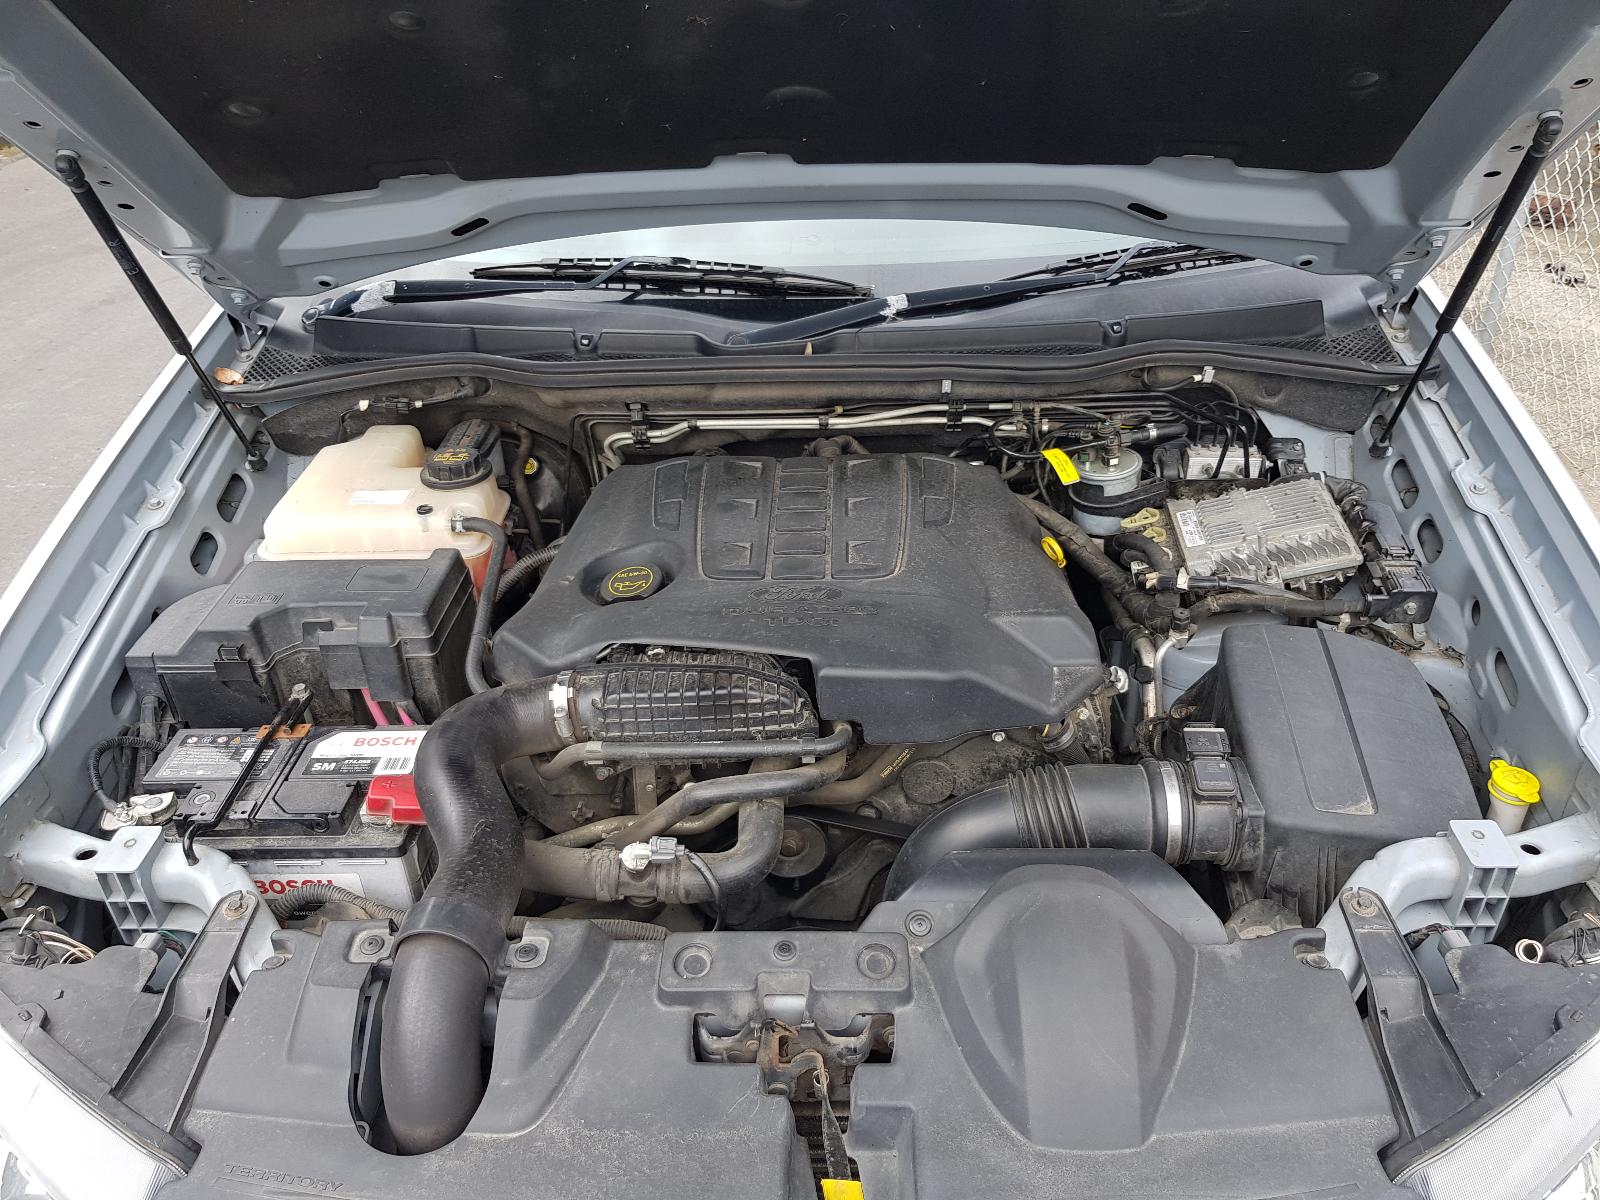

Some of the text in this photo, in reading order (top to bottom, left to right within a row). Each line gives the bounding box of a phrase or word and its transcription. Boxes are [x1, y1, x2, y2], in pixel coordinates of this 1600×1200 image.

[768, 585, 834, 601] Ford
[353, 736, 418, 747] BOSCH
[311, 762, 337, 771] SM
[224, 1164, 344, 1192] TERRITORY
